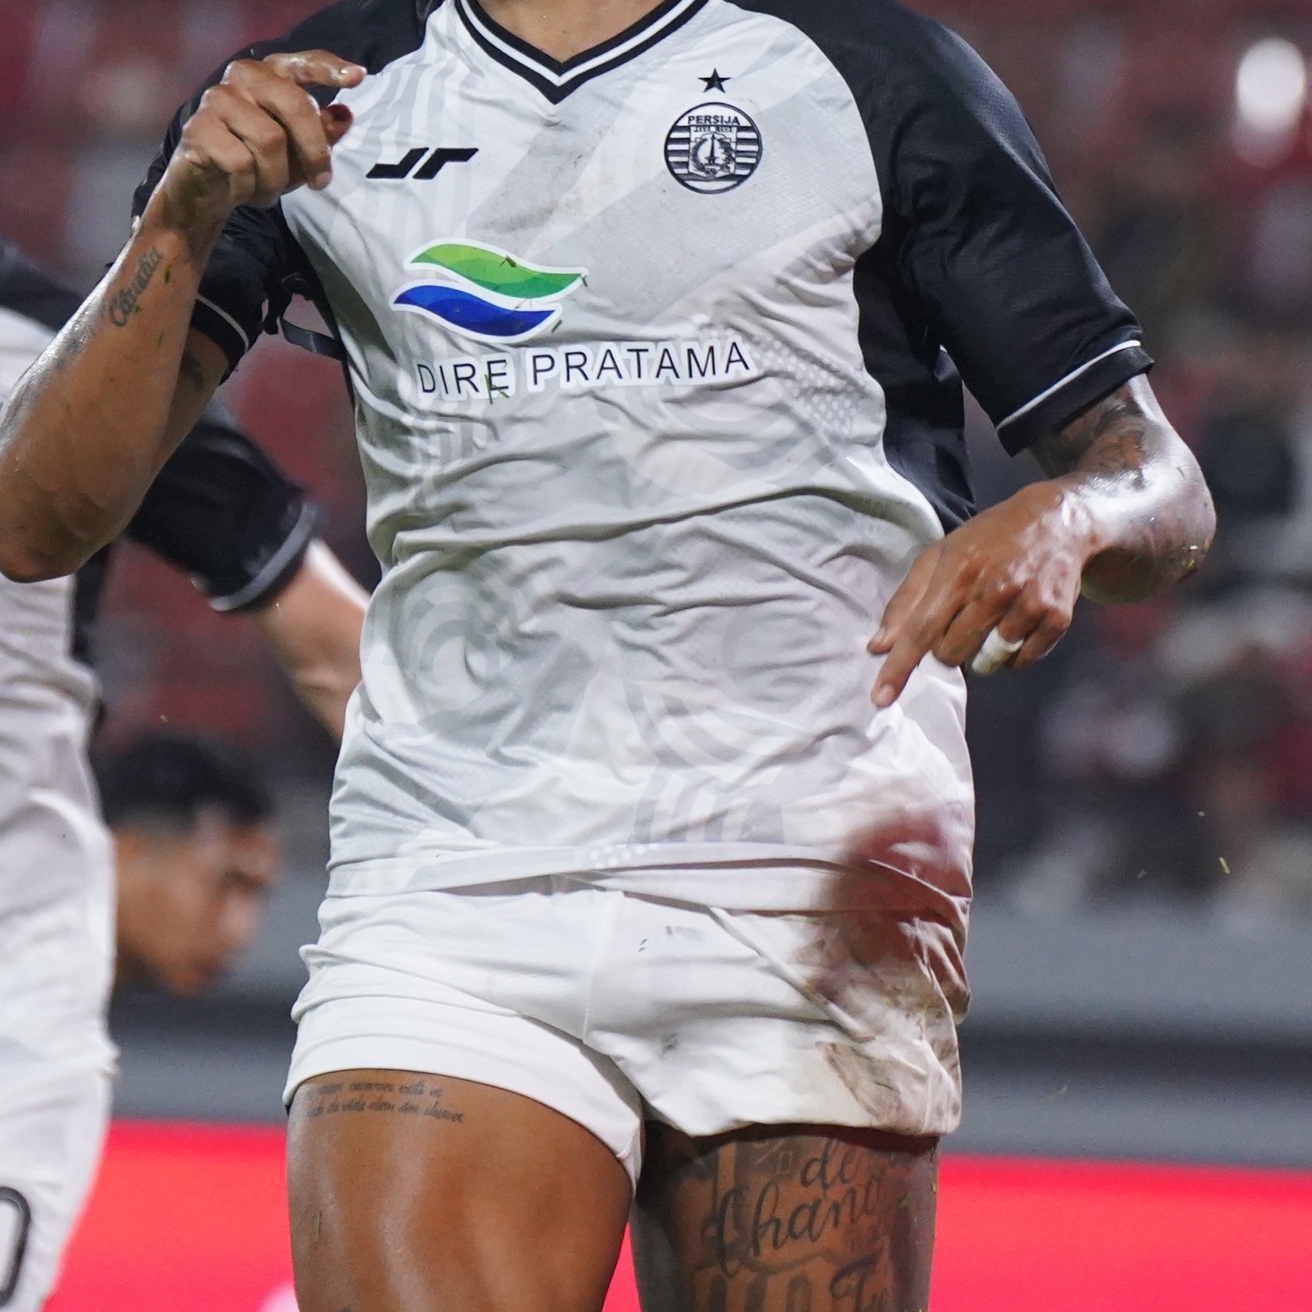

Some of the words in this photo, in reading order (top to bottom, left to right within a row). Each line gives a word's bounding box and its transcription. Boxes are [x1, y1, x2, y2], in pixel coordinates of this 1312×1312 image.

[687, 114, 741, 126] PERSIJA
[417, 359, 510, 395] DIRE
[532, 341, 751, 387] PRATAMA
